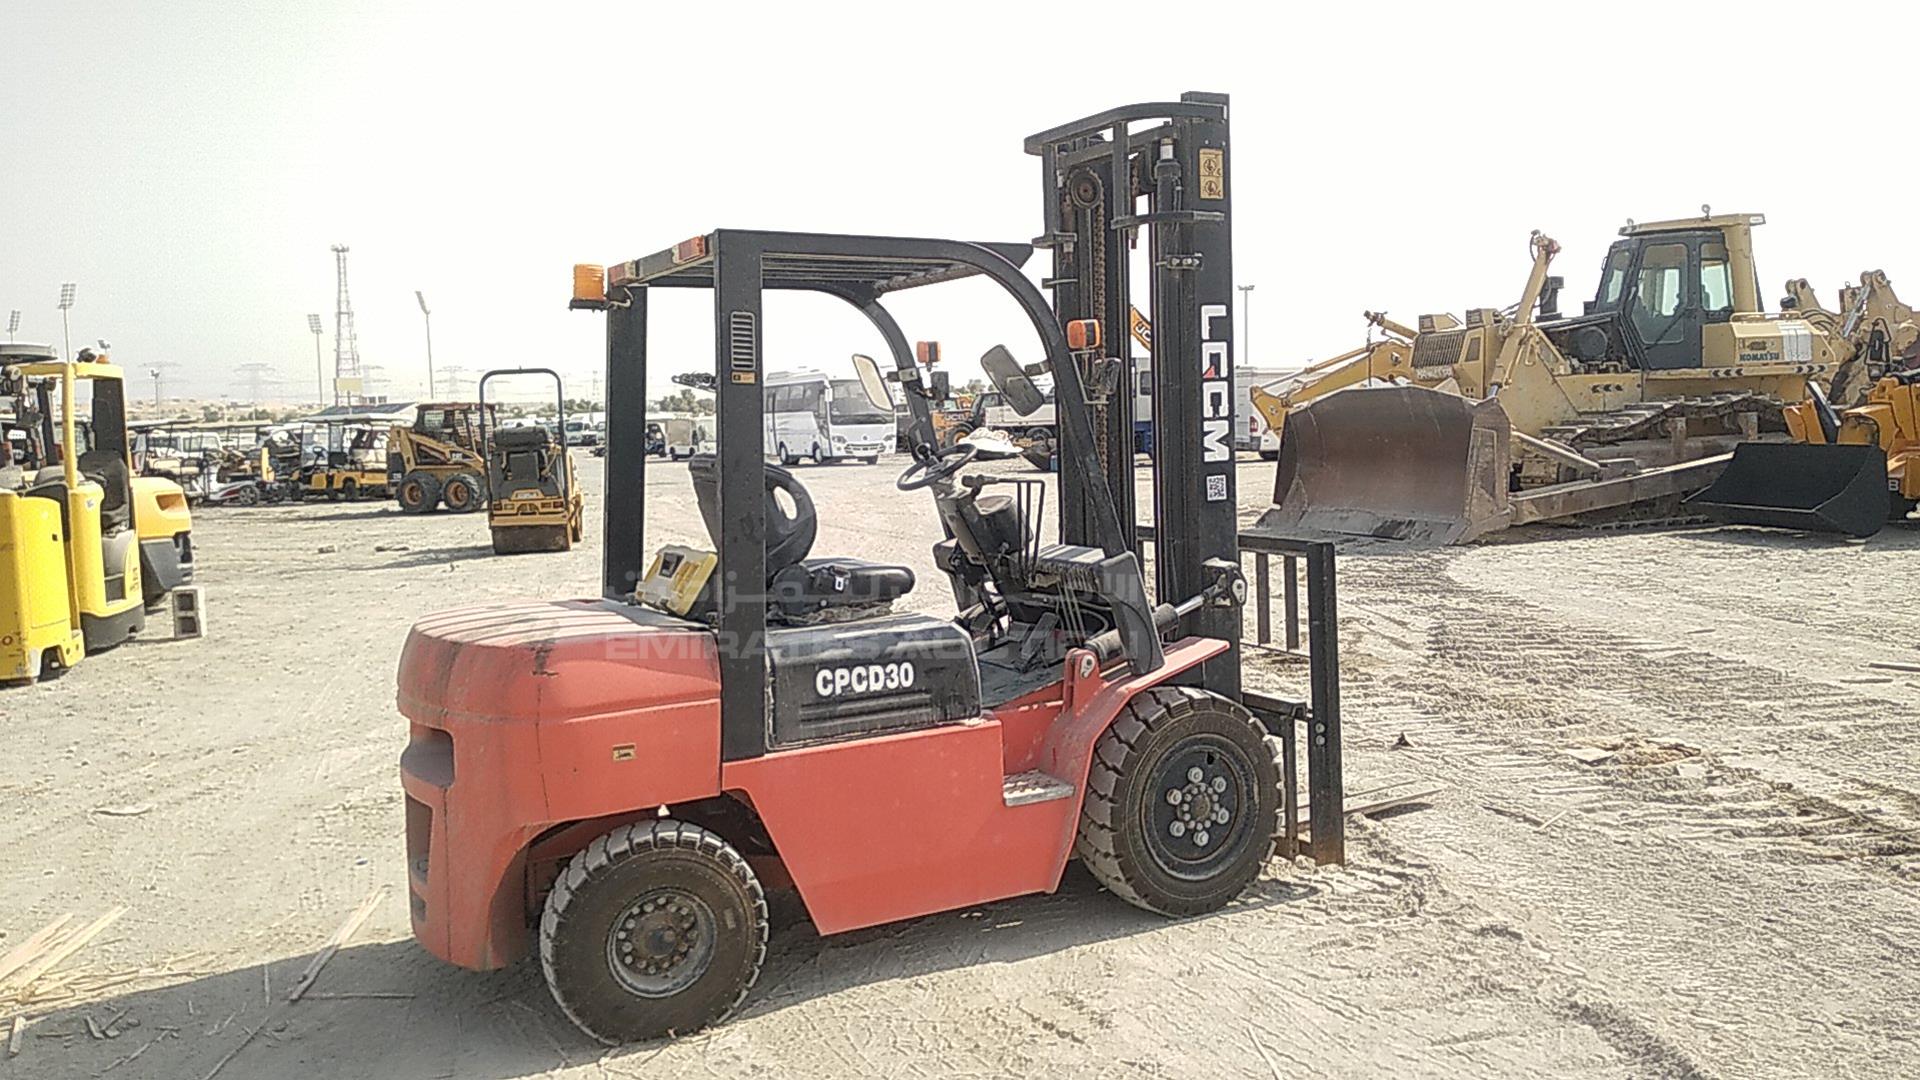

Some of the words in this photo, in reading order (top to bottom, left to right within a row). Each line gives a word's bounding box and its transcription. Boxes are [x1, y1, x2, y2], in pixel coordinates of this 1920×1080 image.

[1135, 325, 1151, 342] JC
[1739, 351, 1780, 361] KOMATSU
[816, 662, 914, 696] CPCD30
